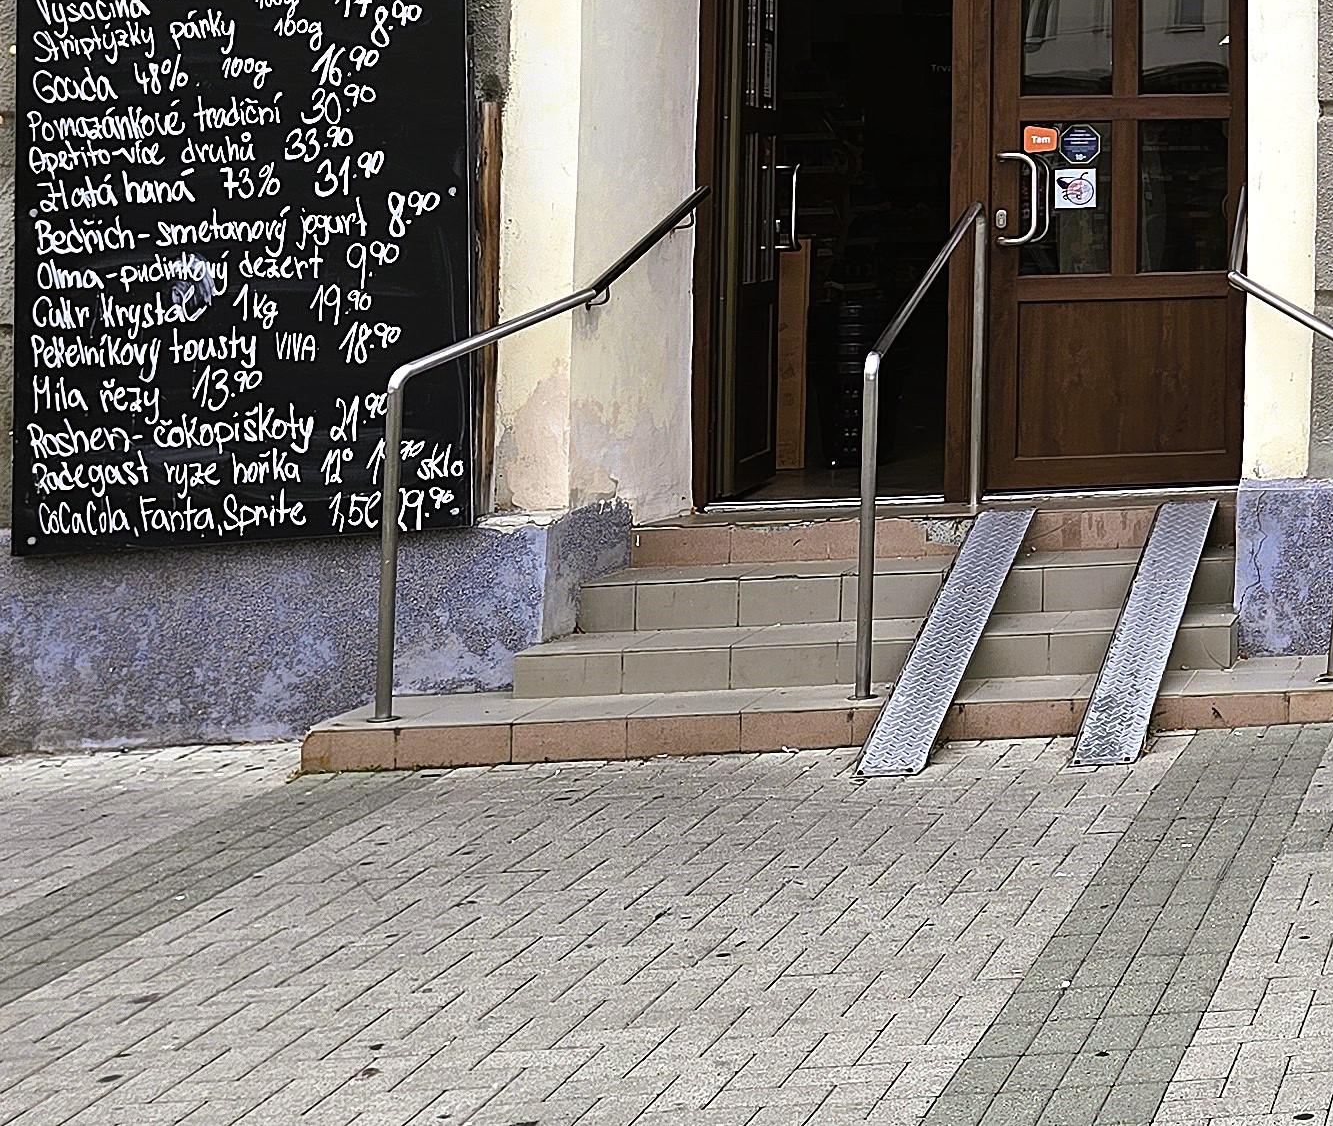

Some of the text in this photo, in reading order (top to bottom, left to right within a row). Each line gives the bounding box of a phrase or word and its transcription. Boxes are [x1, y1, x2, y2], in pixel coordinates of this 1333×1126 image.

[170, 9, 235, 54] párky
[33, 67, 118, 103] Gouda
[27, 99, 185, 142] Pomazánkové
[193, 92, 283, 132] tradiční
[181, 132, 255, 164] druhů
[296, 197, 367, 250] jogurt
[239, 245, 323, 279] dezert
[33, 296, 89, 329] Cukr
[169, 325, 256, 368] tousty
[276, 332, 316, 361] VIVA
[100, 378, 160, 424] řezy
[32, 450, 149, 495] Radegast
[164, 463, 220, 499] ryze
[417, 442, 464, 480] sklo
